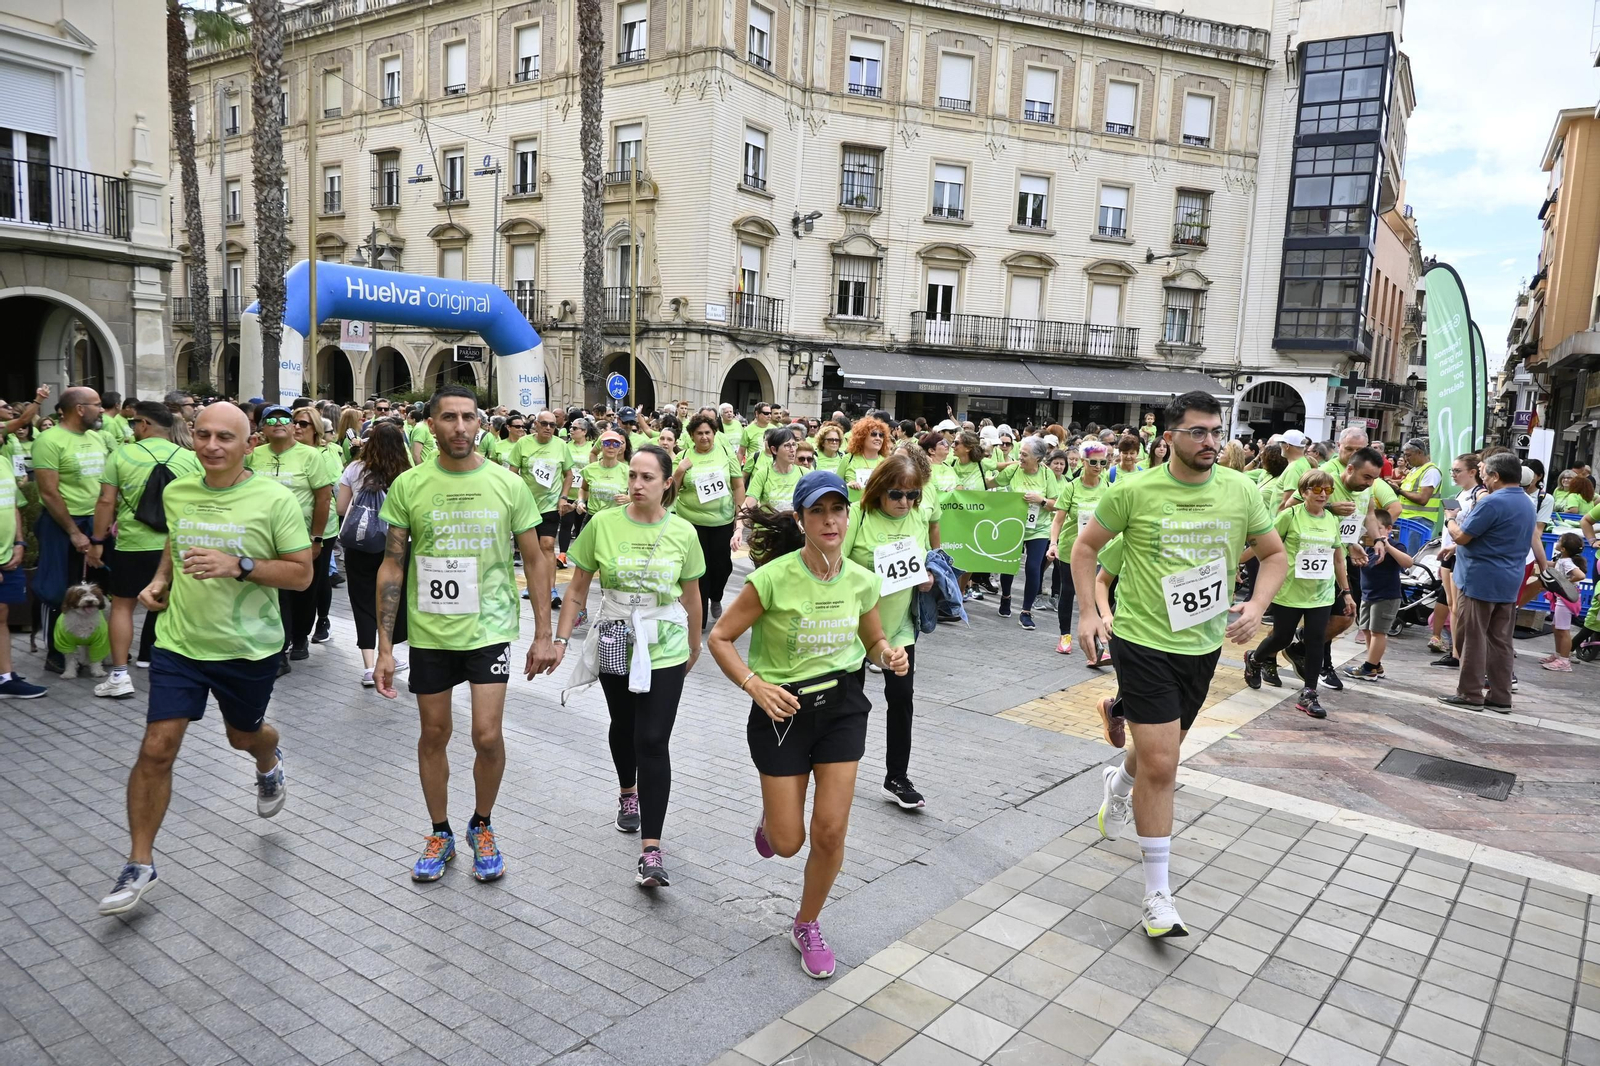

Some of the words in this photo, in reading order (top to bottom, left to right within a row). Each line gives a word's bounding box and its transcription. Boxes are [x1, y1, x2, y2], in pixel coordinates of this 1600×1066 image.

[346, 276, 426, 306] Huelva
[427, 289, 490, 315] original
[279, 360, 301, 370] elva
[534, 468, 550, 481] 424
[432, 510, 449, 520] En
[452, 508, 500, 519] marcha
[179, 518, 194, 530] En
[196, 522, 246, 534] marcha
[434, 522, 482, 536] contra
[484, 522, 497, 534] el
[1162, 518, 1178, 529] En
[1181, 518, 1232, 530] marcha
[176, 534, 224, 548] contra
[227, 536, 243, 549] el
[435, 535, 496, 550] cáncer
[1160, 532, 1212, 544] contra
[1215, 532, 1229, 544] el
[1162, 544, 1226, 560] cáncer
[618, 556, 633, 566] En
[1302, 558, 1328, 570] 367
[662, 569, 674, 581] el
[430, 580, 460, 600] 80
[800, 617, 816, 629] En
[798, 631, 846, 644] contra
